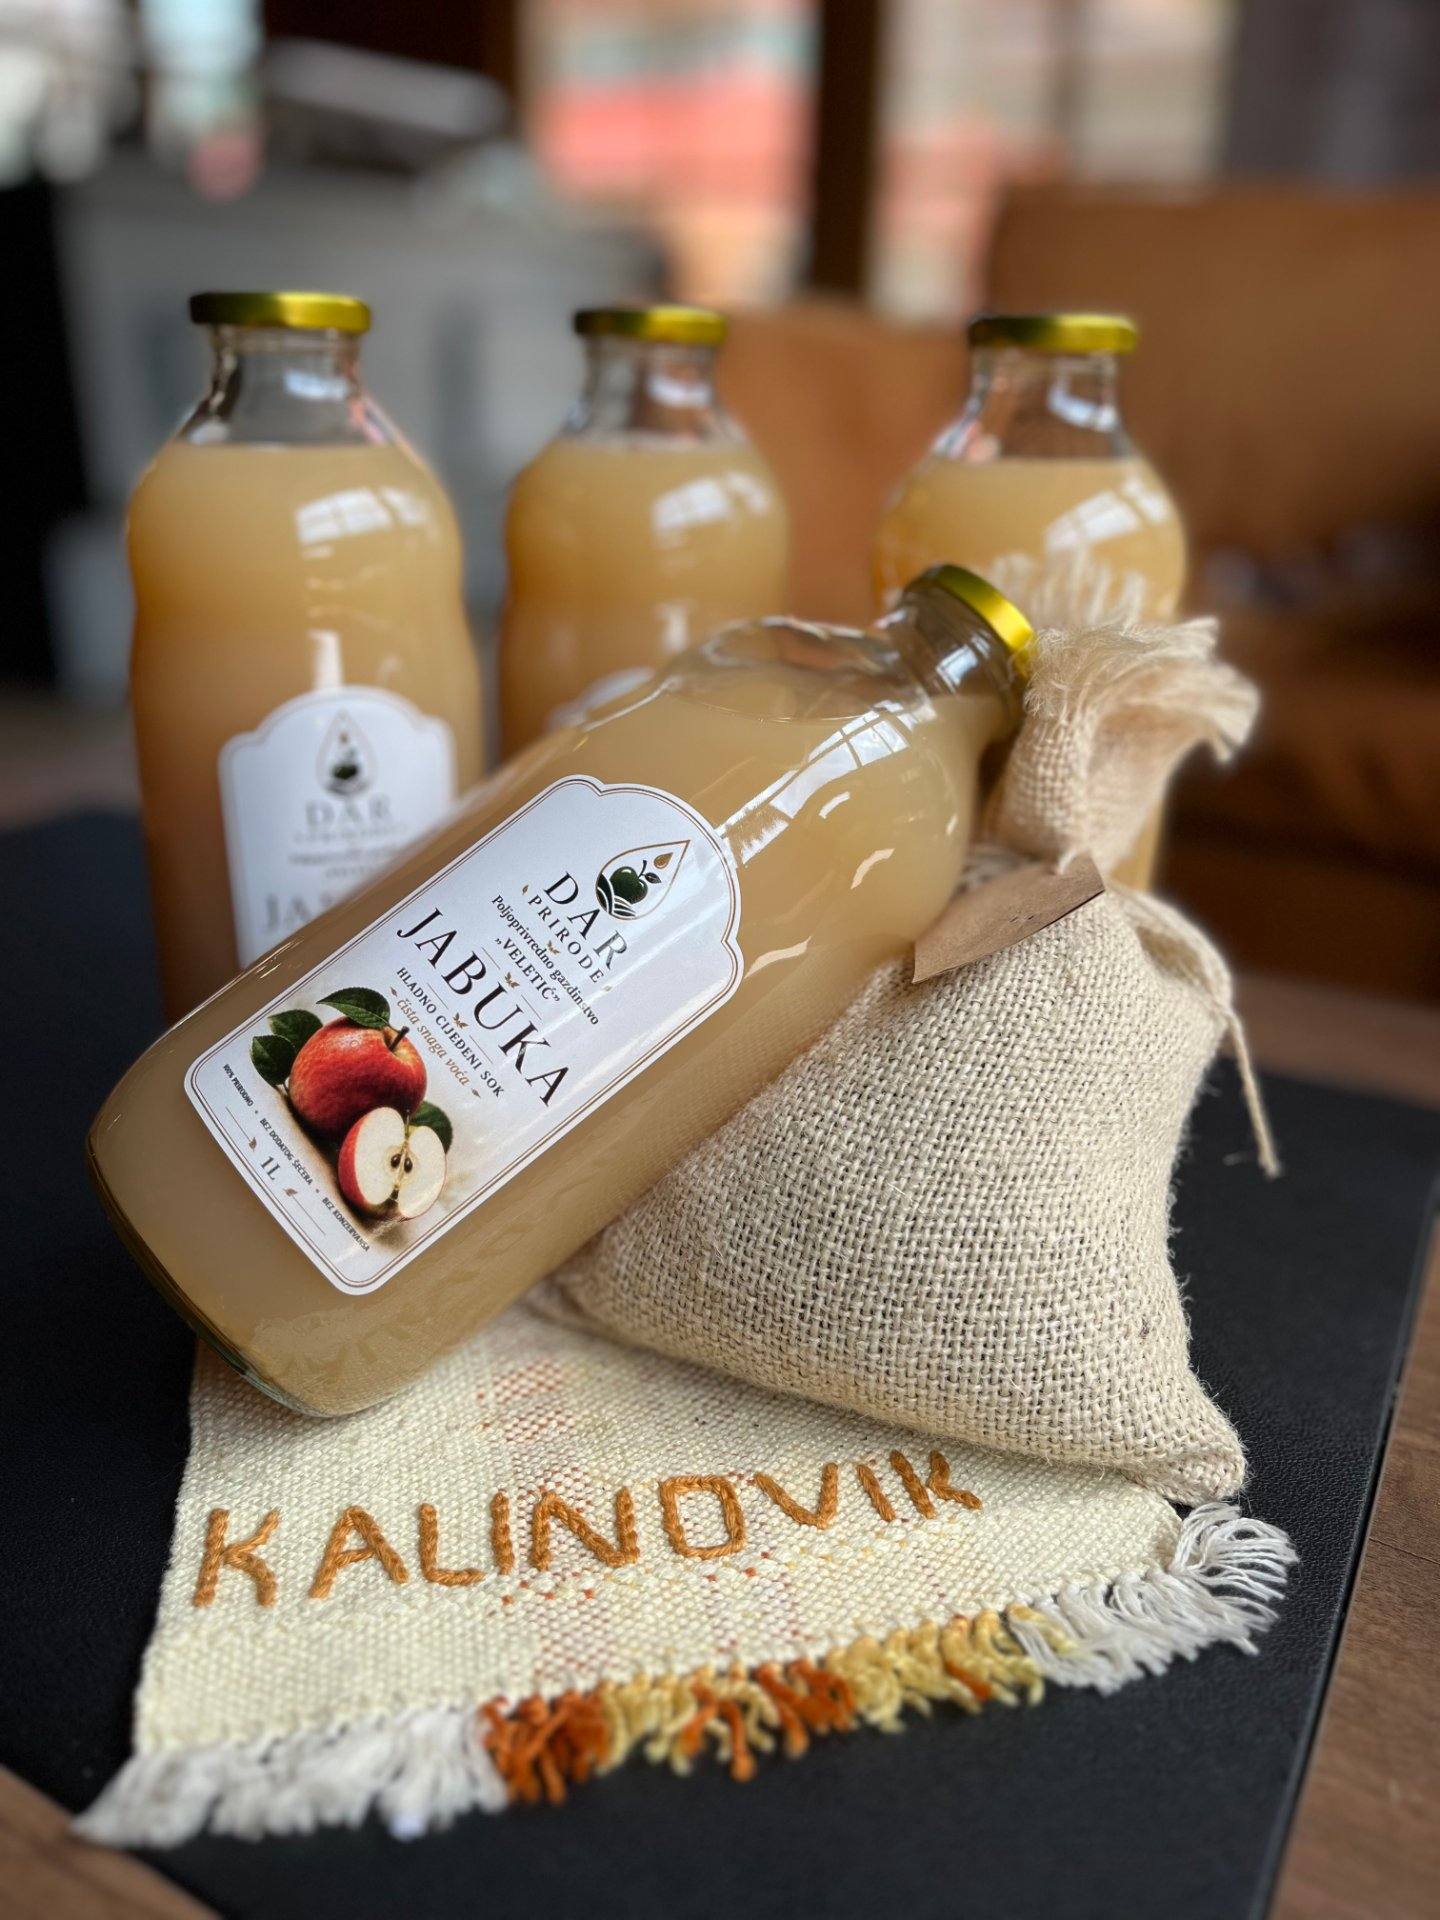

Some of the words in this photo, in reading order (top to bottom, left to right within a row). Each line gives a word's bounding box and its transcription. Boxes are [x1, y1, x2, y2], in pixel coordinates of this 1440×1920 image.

[492, 894, 554, 969] Poljoprivredno
[550, 967, 599, 1025] gazdinstvo
[528, 895, 604, 983] PRIRODE
[544, 871, 628, 970] DAR
[396, 967, 437, 1014] HLADNO
[435, 1015, 482, 1070] CIJEĐENI
[480, 1070, 504, 1097] SOK
[397, 907, 569, 1107] JABUKA
[417, 1025, 448, 1059] snaga
[231, 1076, 254, 1107] PRIRODNO
[259, 1117, 272, 1134] BEZ
[269, 1130, 294, 1162] DODATOG
[322, 1197, 335, 1212] BEZ
[332, 1208, 370, 1252] KONZERVANSA
[260, 1155, 281, 1181] 1L
[194, 1449, 982, 1607] KALINOVIK
